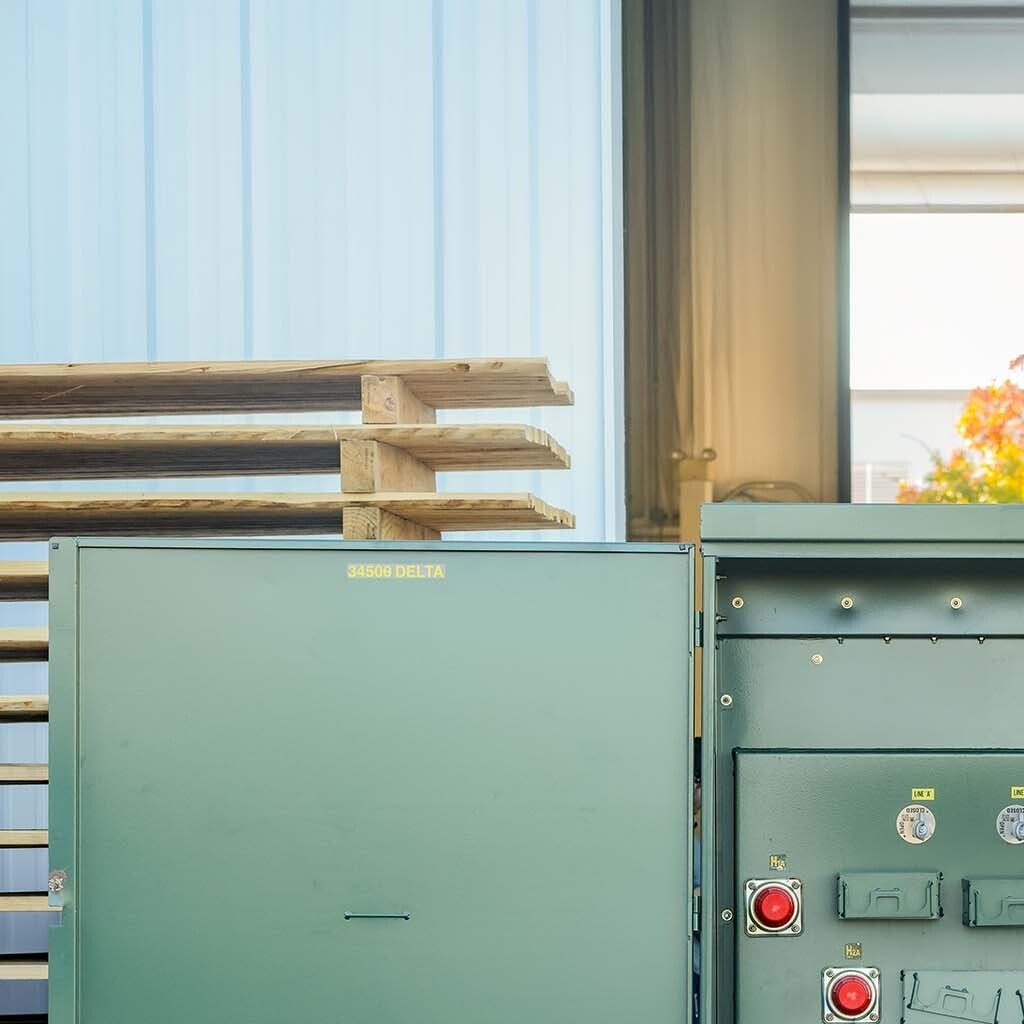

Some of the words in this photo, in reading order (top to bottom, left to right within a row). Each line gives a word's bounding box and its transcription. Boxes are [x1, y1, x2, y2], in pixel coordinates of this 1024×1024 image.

[395, 563, 445, 578] DELTA
[913, 790, 924, 798] LINE
[1013, 788, 1024, 796] LINE
